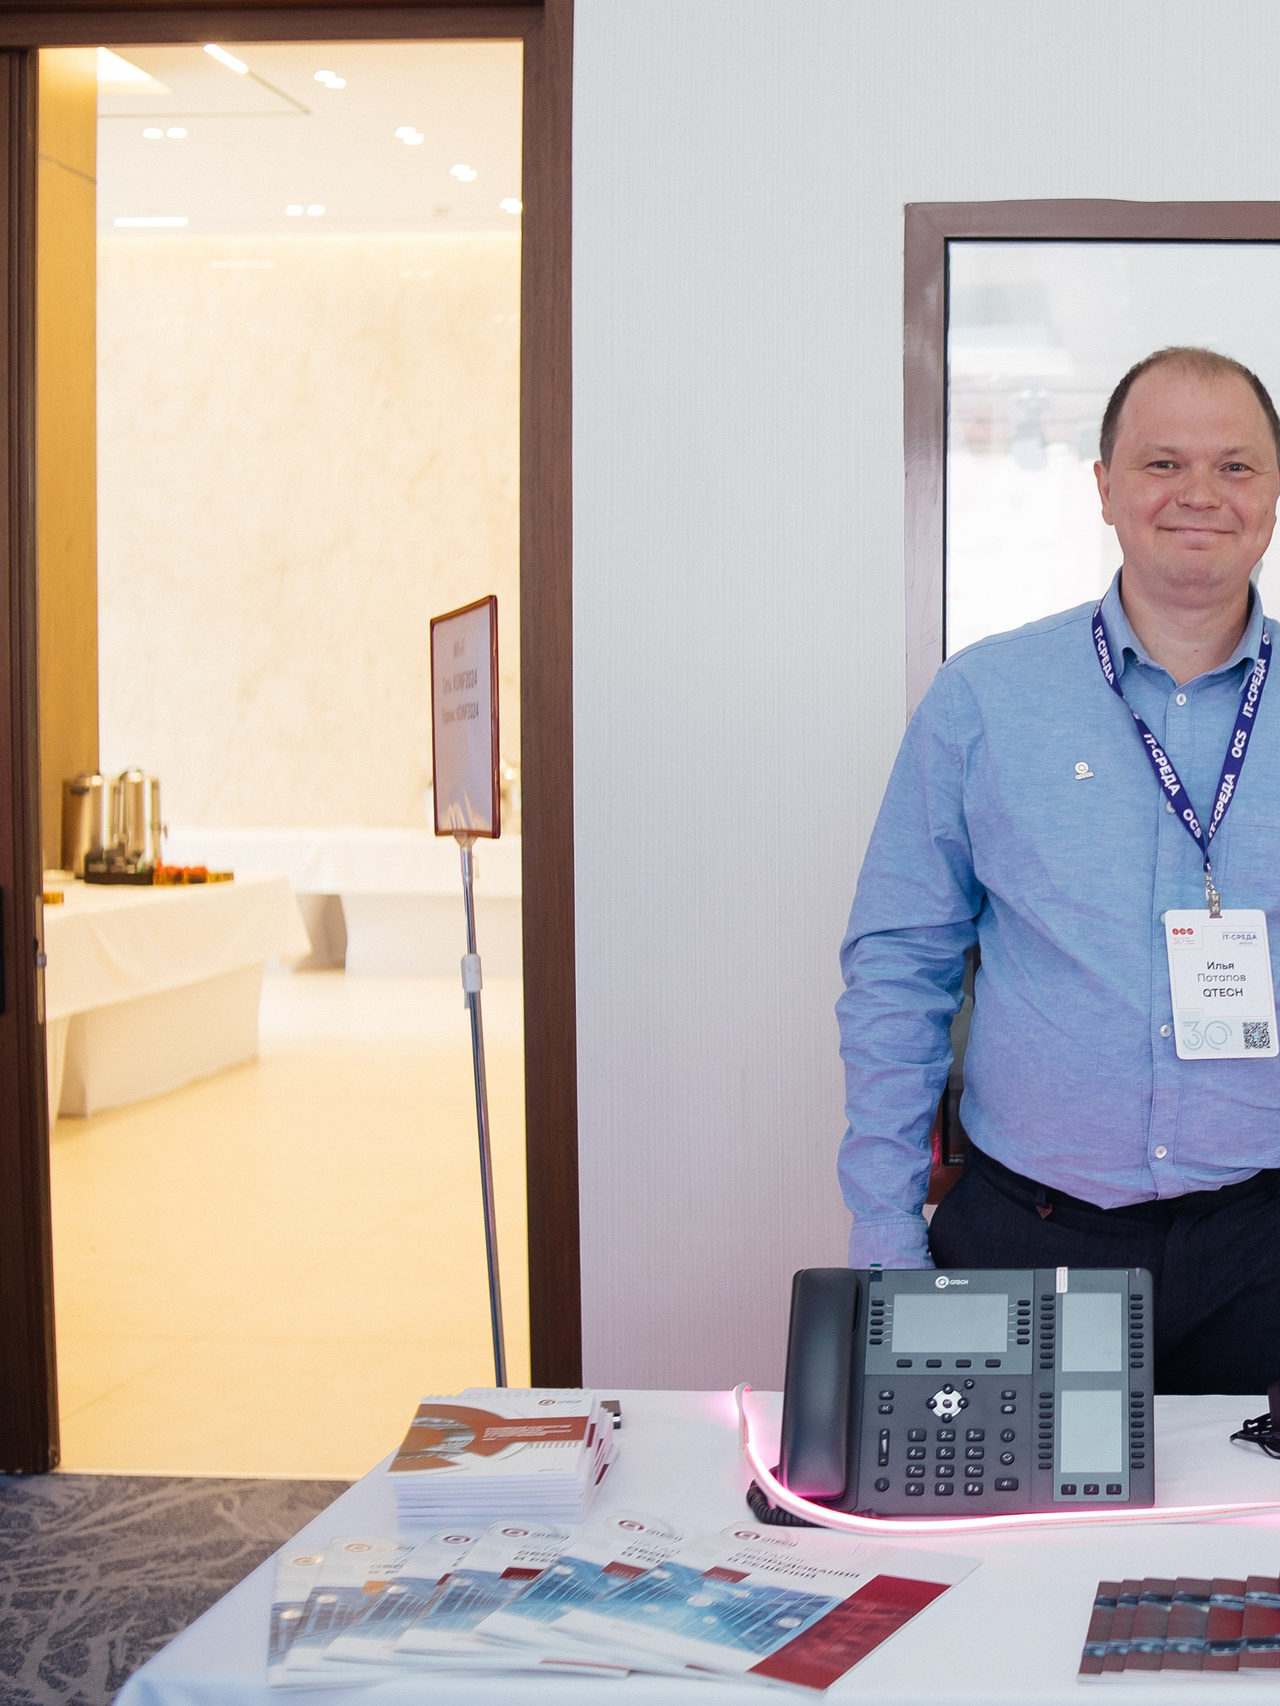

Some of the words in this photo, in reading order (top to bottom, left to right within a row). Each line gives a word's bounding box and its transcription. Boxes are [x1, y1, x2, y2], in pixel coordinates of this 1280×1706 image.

[1094, 625, 1115, 685] IT-СРЕДА
[1231, 729, 1247, 759] OCS
[1242, 658, 1267, 718] IT-СРЕДА
[1143, 733, 1182, 797] IT-СРЕДА
[1182, 808, 1203, 839] OCS
[1197, 973, 1247, 983] Потапов
[1207, 961, 1235, 970] Илья
[1202, 988, 1244, 997] QTECH
[1182, 1020, 1234, 1051] 30
